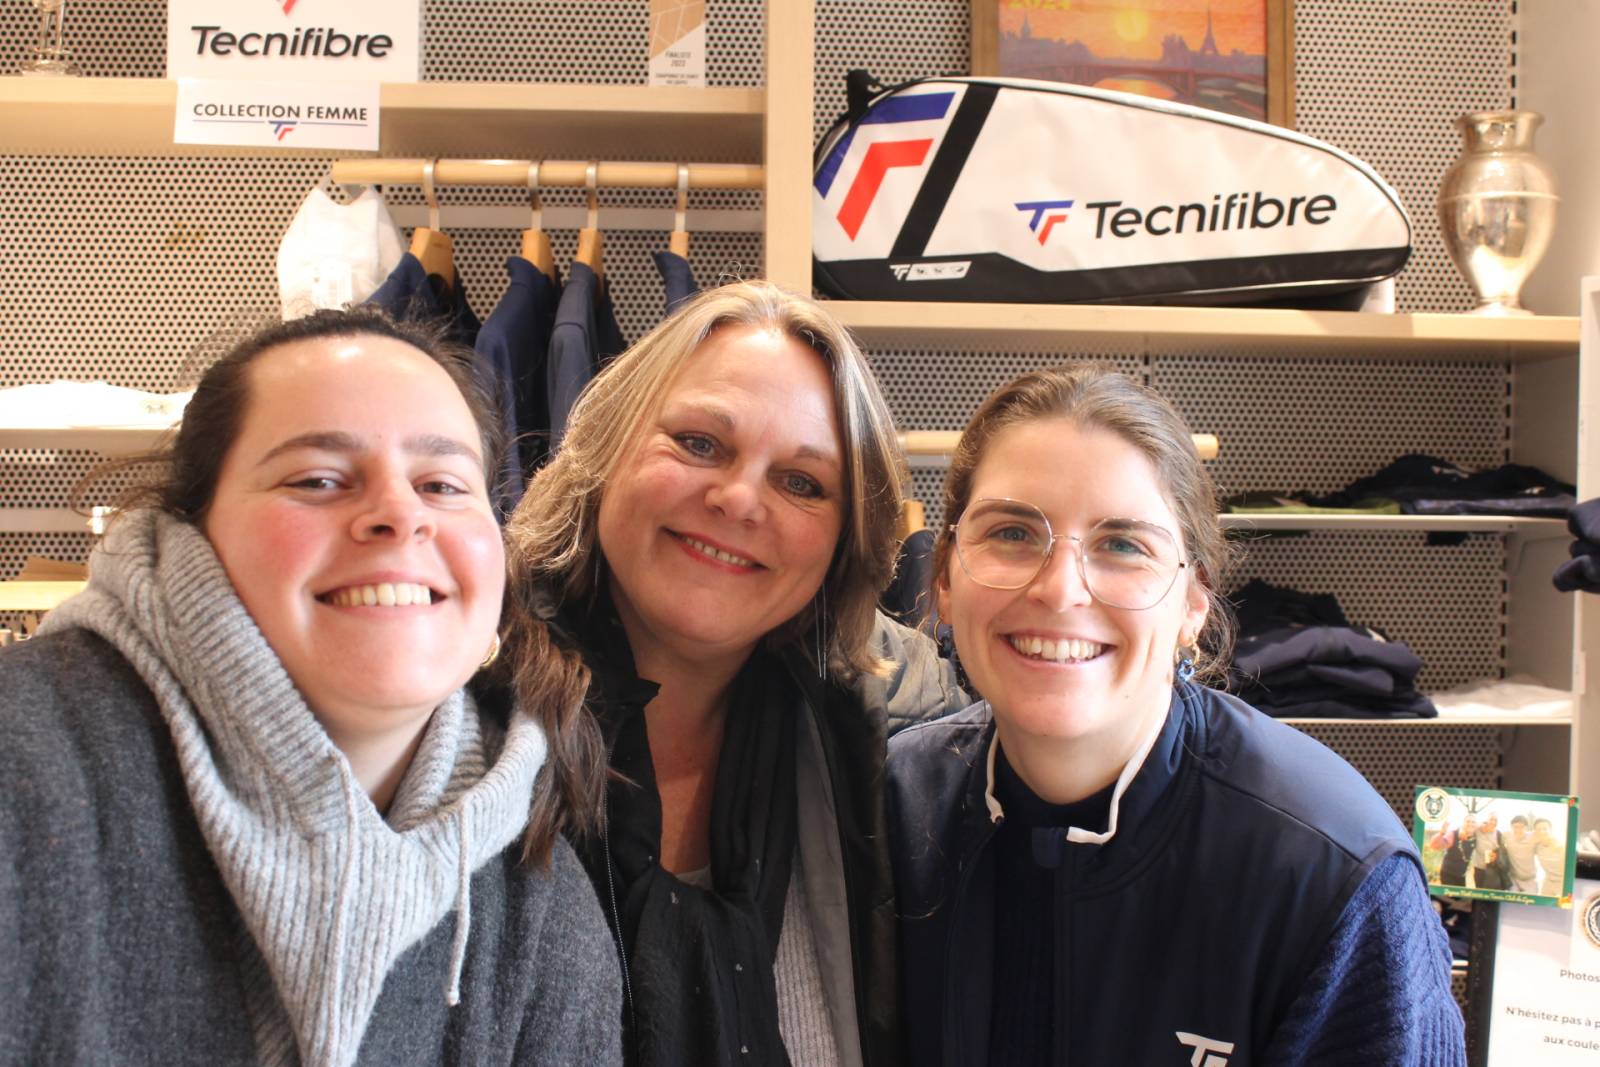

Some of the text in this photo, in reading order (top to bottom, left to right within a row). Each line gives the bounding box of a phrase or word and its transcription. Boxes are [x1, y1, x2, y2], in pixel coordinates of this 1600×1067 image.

[191, 26, 393, 58] Tecnifibre
[193, 103, 368, 121] COLLECTION FEMME
[1085, 191, 1338, 239] Tecnifibre
[1561, 1016, 1582, 1026] pas
[1543, 1035, 1564, 1045] aux
